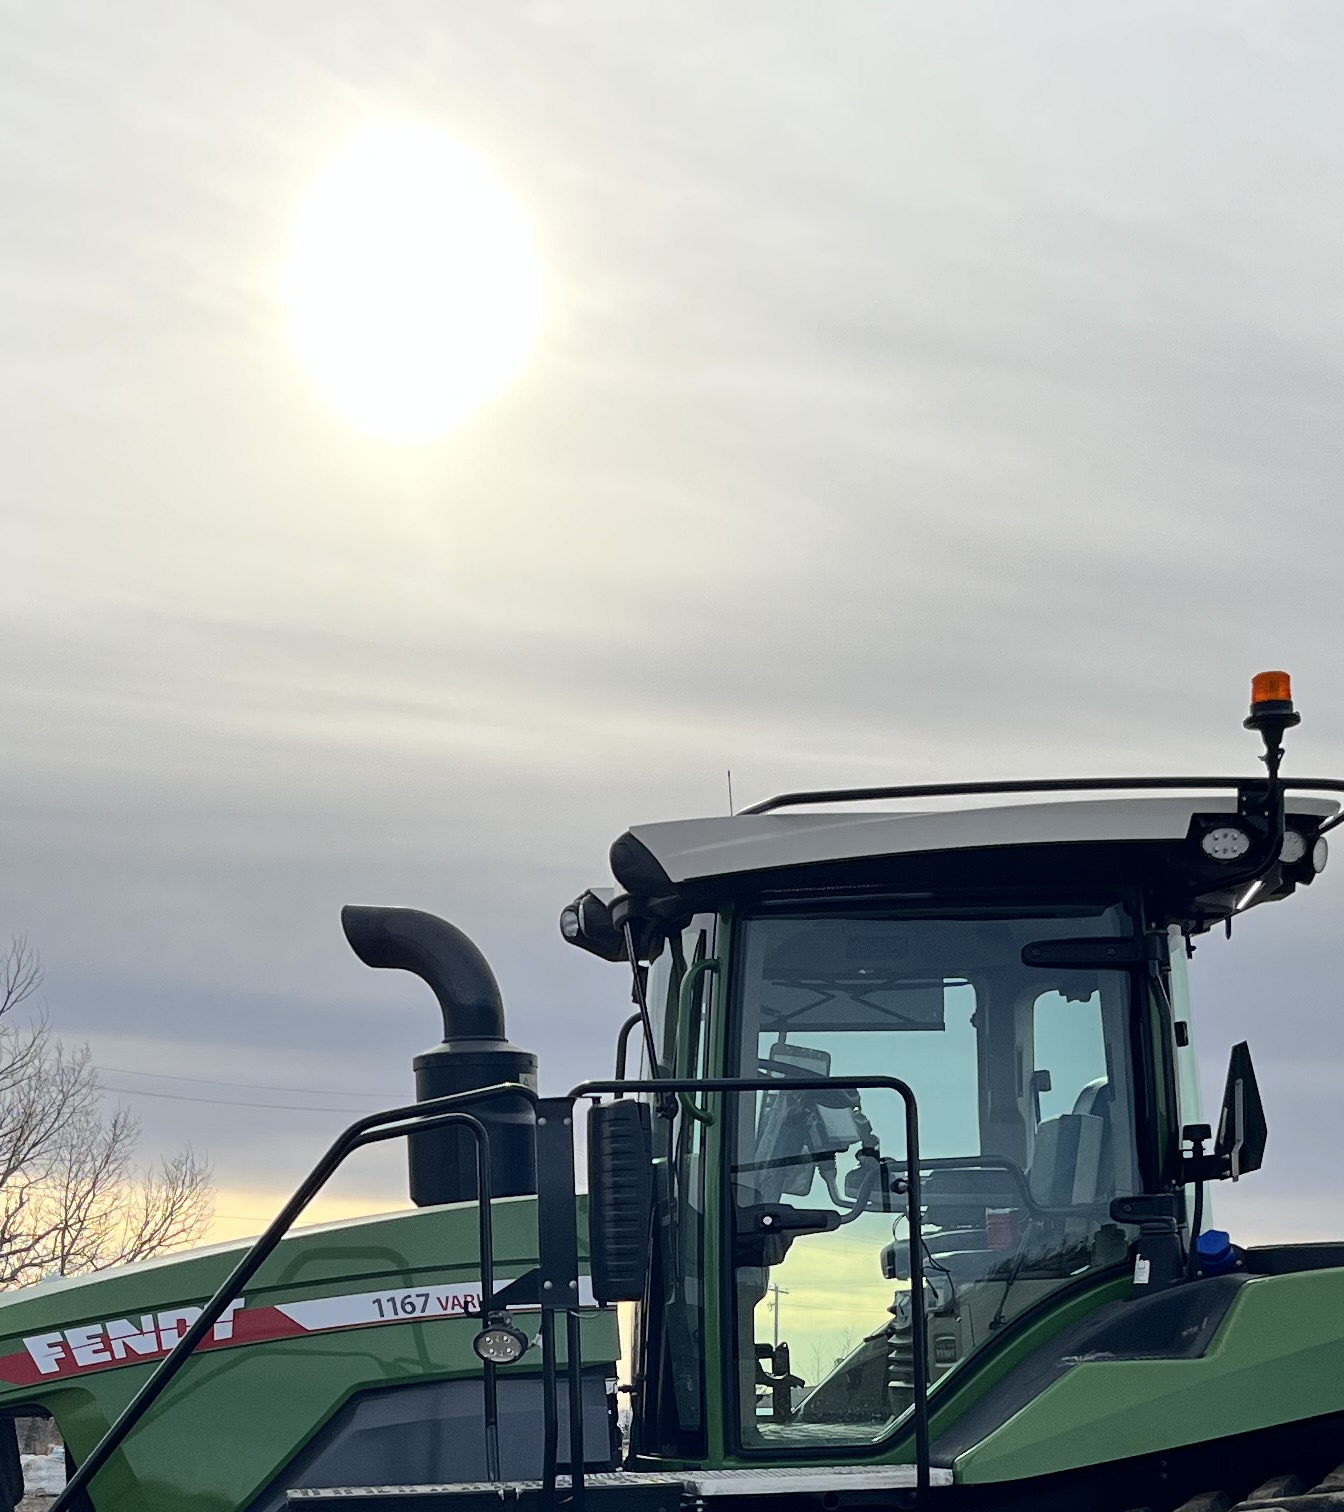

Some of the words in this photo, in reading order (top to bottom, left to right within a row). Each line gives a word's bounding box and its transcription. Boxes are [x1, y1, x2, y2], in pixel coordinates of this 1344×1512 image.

[372, 1293, 430, 1318] 1167
[436, 1293, 483, 1312] VARI
[22, 1298, 245, 1375] FENDT
